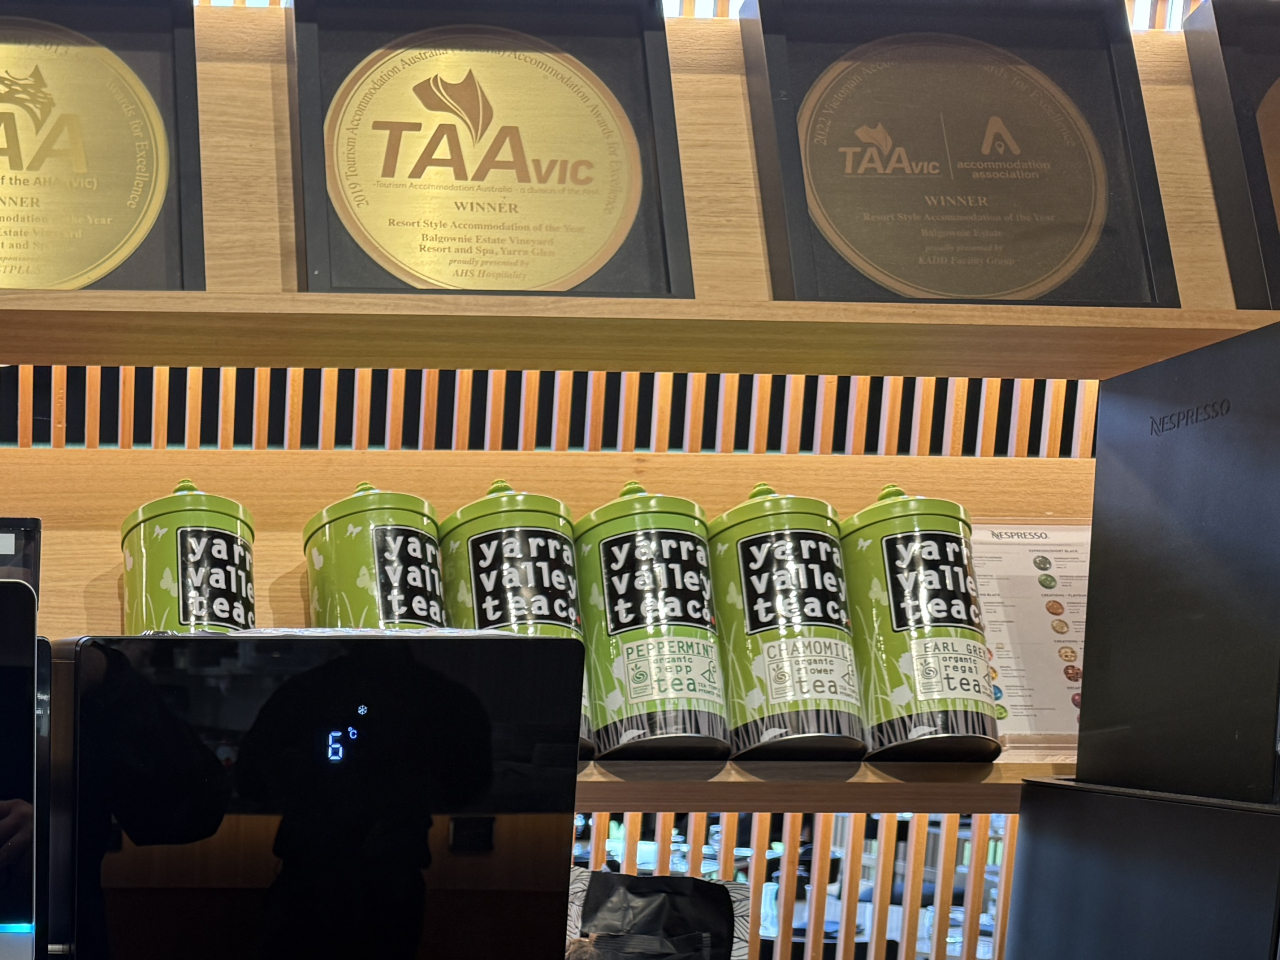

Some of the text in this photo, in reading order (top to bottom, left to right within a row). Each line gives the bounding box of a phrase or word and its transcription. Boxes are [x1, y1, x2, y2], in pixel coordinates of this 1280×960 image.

[507, 50, 591, 106] Accommodation
[345, 65, 402, 137] Accommodation
[129, 119, 144, 138] for
[586, 104, 616, 141] Awards
[813, 116, 832, 146] 2022
[343, 136, 359, 182] Tourism
[956, 160, 1051, 170] accommodation
[9, 174, 30, 187] the
[33, 176, 63, 187] AHA
[66, 177, 98, 191] (VIC)
[126, 141, 150, 209] Excellence
[971, 169, 1040, 179] association
[348, 181, 370, 210] 2019
[375, 180, 407, 191] Tourism
[408, 182, 475, 193] Accommodation
[476, 184, 513, 194] Australia
[454, 201, 519, 214] WINNER
[923, 195, 989, 207] WINNER
[86, 215, 113, 226] Year
[388, 218, 420, 229] Resort
[422, 219, 448, 230] Style
[450, 220, 530, 232] Accommodation
[532, 223, 544, 232] of
[545, 223, 561, 233] the
[8, 240, 29, 250] and
[419, 243, 452, 254] Resort
[454, 244, 473, 254] and
[421, 233, 554, 247] Balgownie Estate Vineyard
[1149, 399, 1231, 438] NESPRESSO
[988, 530, 1051, 541] NESPRESSO
[479, 537, 575, 568] yarra
[610, 538, 708, 571] yarra
[748, 539, 842, 571] yarra
[479, 561, 577, 600] valley
[610, 563, 711, 601] valley
[749, 563, 847, 602] valley
[625, 640, 715, 660] PEPPERMINT
[923, 641, 959, 654] EARL
[652, 656, 693, 665] organic
[794, 658, 835, 666] organic
[942, 656, 978, 665] organic
[795, 667, 835, 675] flower
[943, 664, 979, 675] regal
[653, 677, 697, 693] tea
[795, 677, 838, 695] tea
[943, 673, 982, 695] tea
[328, 731, 343, 761] 6
